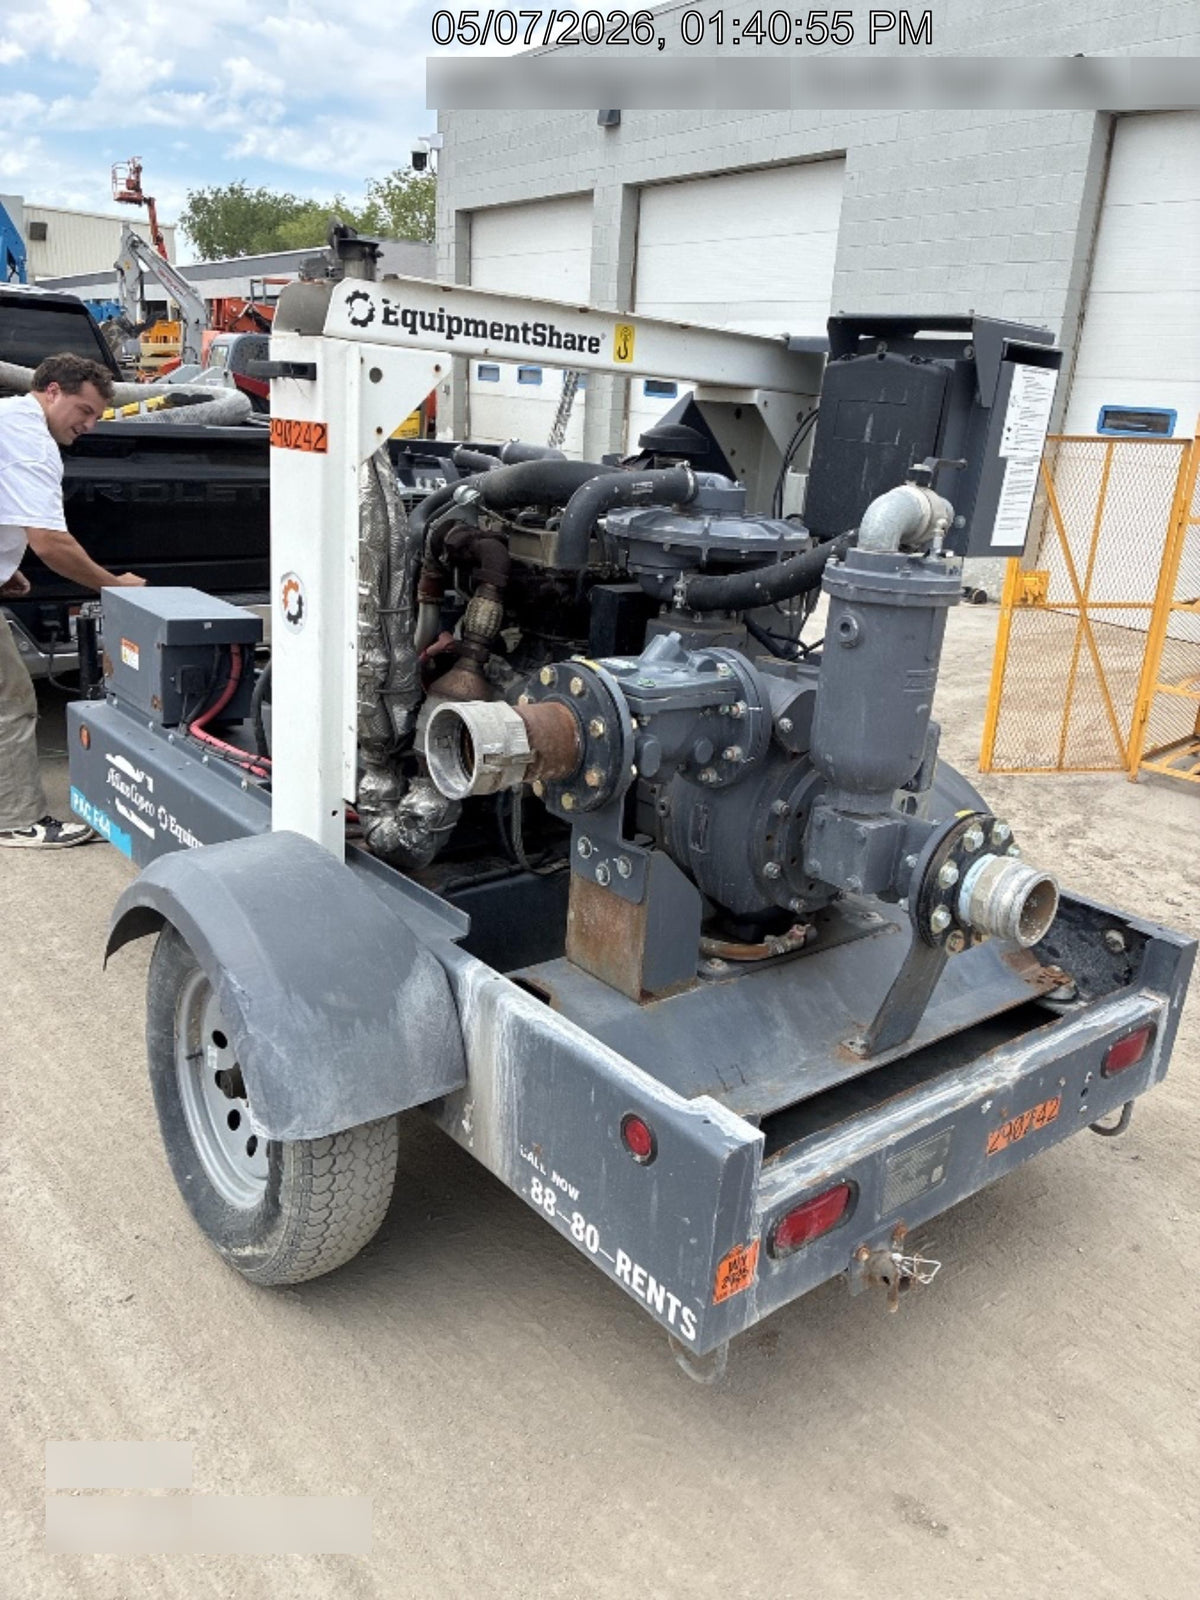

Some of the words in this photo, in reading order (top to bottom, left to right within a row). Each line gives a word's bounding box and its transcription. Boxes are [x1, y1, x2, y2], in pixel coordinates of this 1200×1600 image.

[381, 298, 601, 354] EquipmentShare
[106, 767, 130, 798] Atlas
[130, 783, 155, 817] Copco
[550, 1170, 580, 1201] NOW
